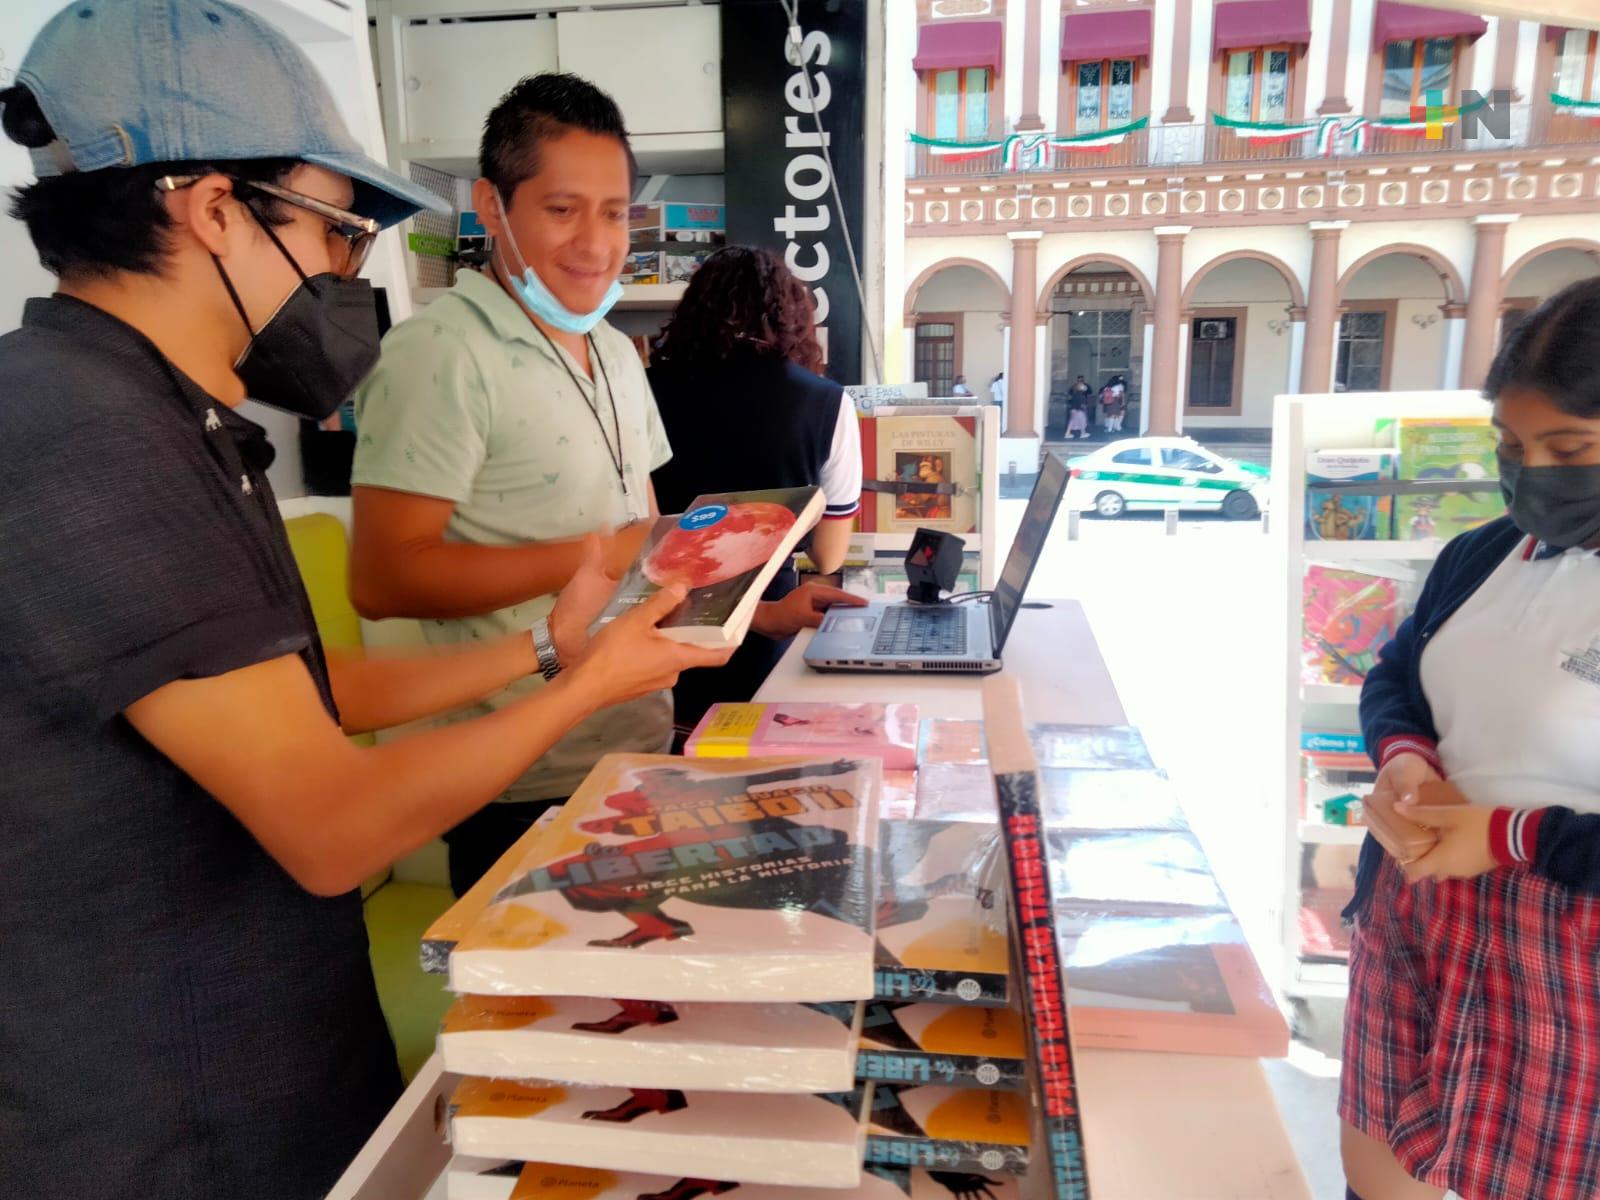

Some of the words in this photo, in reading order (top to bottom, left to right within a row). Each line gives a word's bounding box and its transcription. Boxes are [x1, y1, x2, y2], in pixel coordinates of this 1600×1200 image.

[617, 794, 809, 838] TAIBO
[528, 825, 835, 891] LIBERTAD
[663, 878, 722, 897] PARA
[728, 872, 752, 886] LA
[757, 857, 856, 880] HISTORIA
[699, 855, 813, 883] HISTORIAS
[1010, 837, 1049, 924] TAIBO
[1023, 926, 1065, 1040] IGNACIO
[1040, 1042, 1078, 1118] PACO
[557, 1177, 600, 1189] Planeta
